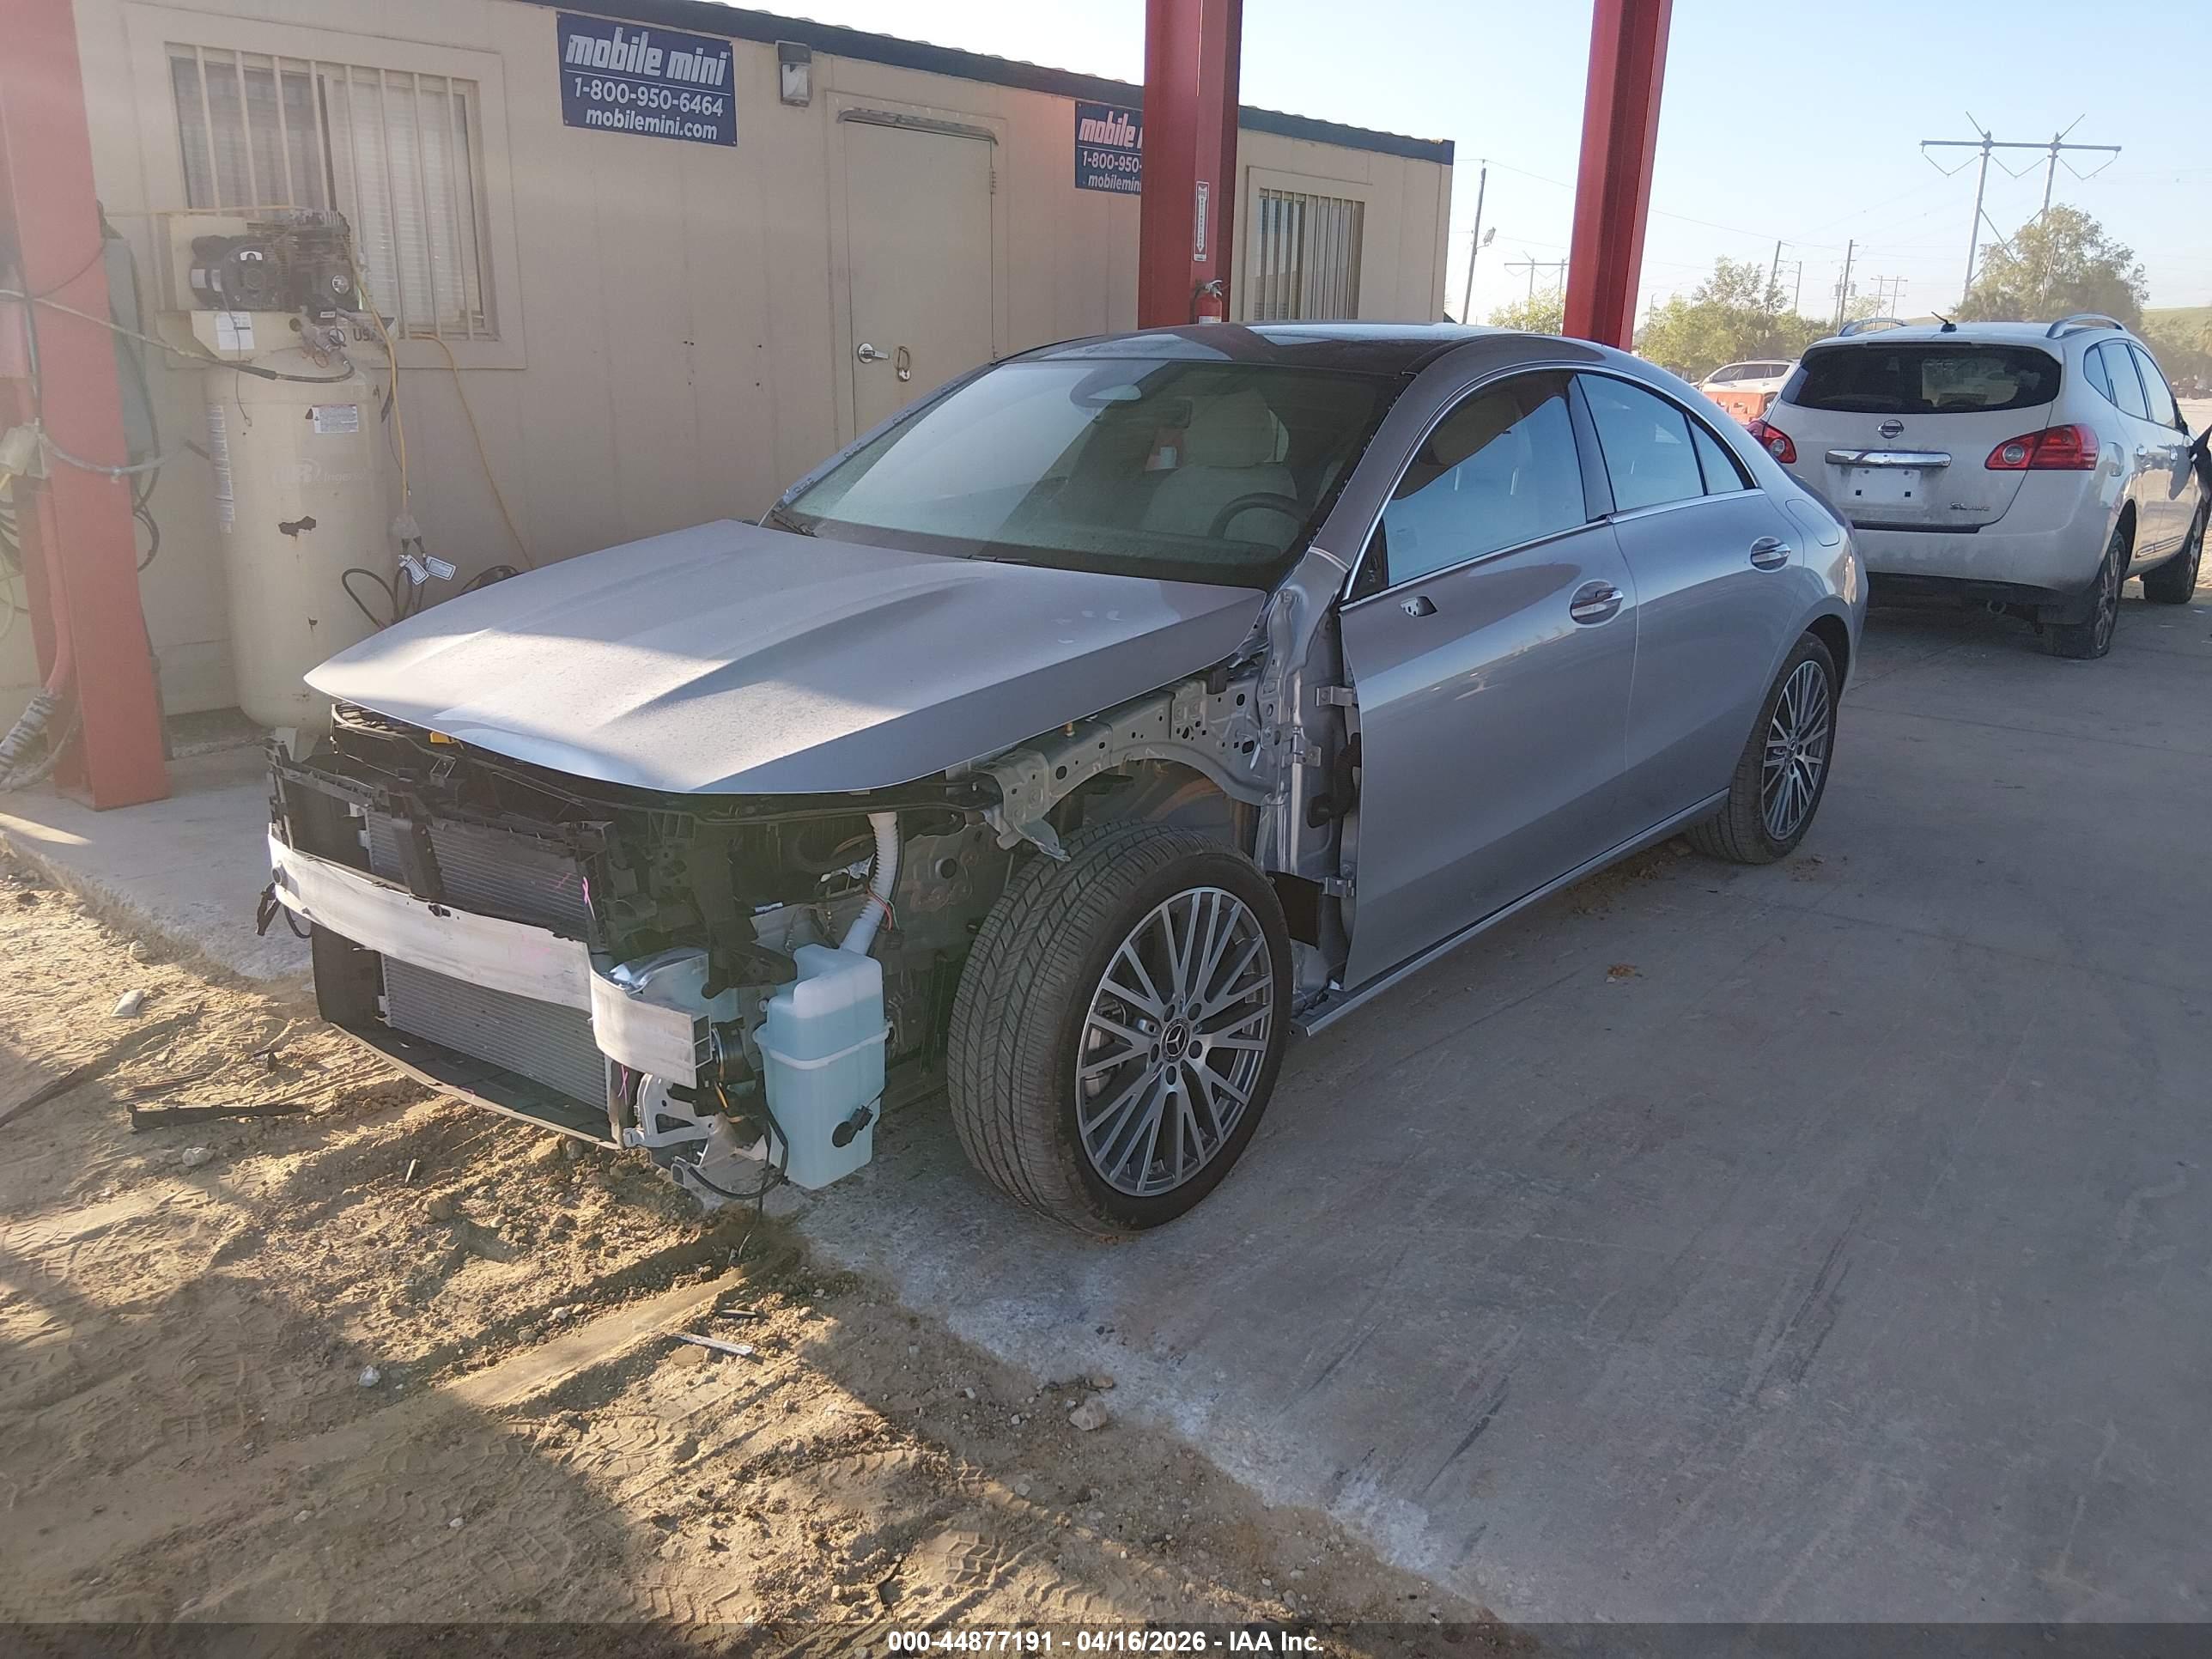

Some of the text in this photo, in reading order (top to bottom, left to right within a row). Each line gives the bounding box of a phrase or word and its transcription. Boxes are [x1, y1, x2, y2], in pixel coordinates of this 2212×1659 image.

[565, 27, 727, 86] mobile mini
[574, 77, 723, 117] 1-800-950-6464
[586, 108, 718, 140] mobilemini.com
[1078, 110, 1136, 148] mobile
